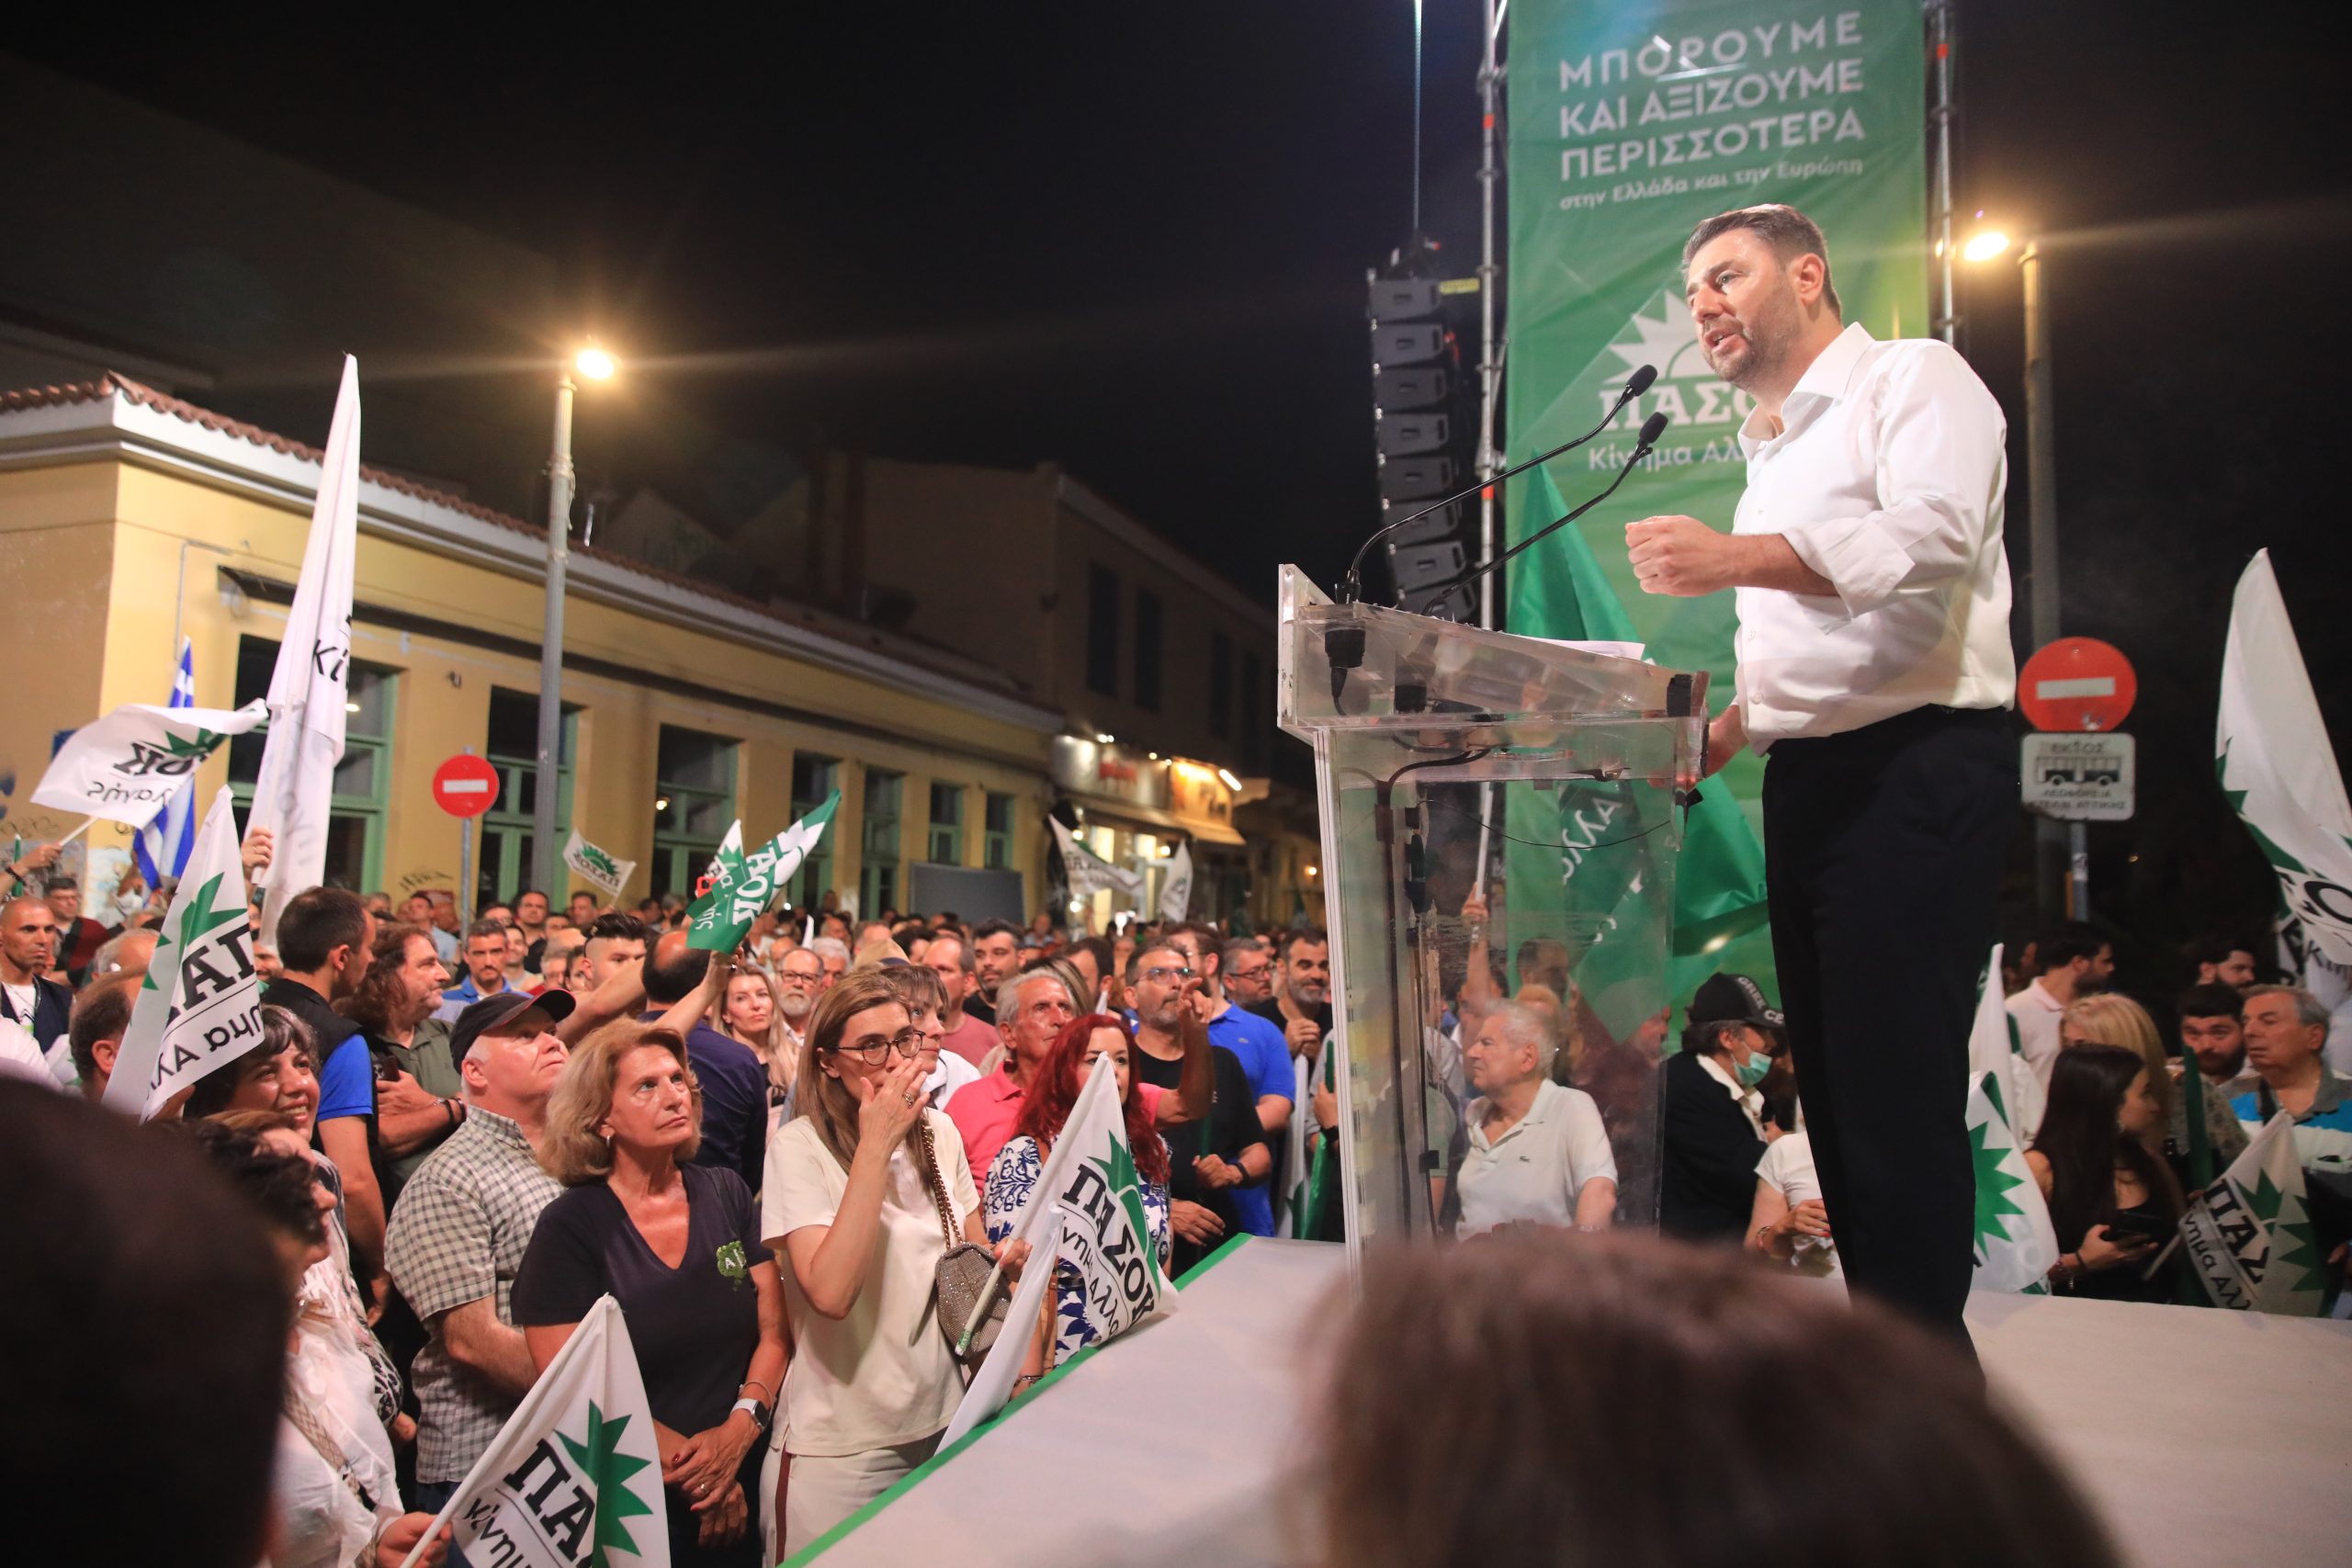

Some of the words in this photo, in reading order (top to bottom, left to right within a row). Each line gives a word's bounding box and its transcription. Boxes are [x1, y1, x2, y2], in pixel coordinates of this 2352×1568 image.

[1561, 11, 1862, 92] ΜΠΟΡΟΥΜΕ
[1561, 95, 1627, 138] ΚΑΙ
[1638, 58, 1863, 126] ΑΞΙΖΟΥΜΕ
[1562, 107, 1865, 181] ΠΕΡΙΣΣΟΤΕΡΑ
[1560, 190, 1606, 210] στην
[1612, 176, 1689, 203] Ελλάδα
[1697, 172, 1728, 189] και
[1734, 165, 1770, 187] την
[1061, 1163, 1155, 1325] ΠΑΣΟΚ
[503, 1438, 595, 1568] ΠΑ
